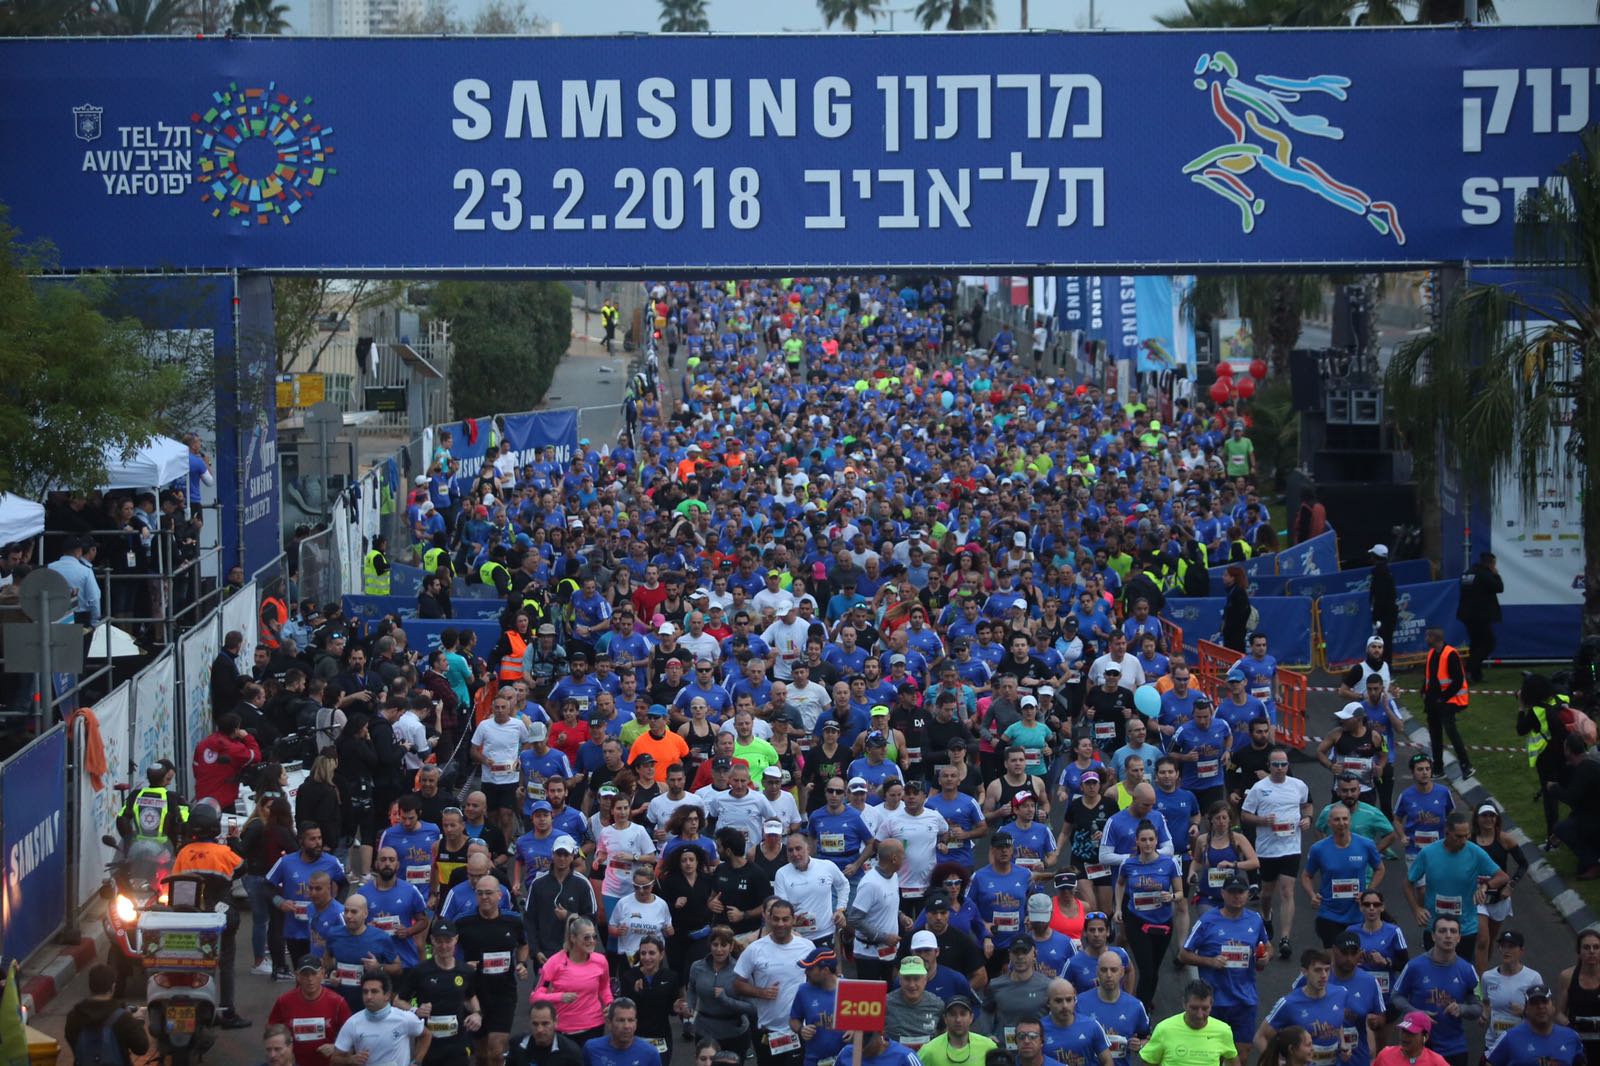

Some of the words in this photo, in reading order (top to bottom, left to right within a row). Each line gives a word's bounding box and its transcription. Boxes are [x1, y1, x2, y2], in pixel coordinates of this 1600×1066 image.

[452, 76, 852, 140] SAMSUNG
[877, 74, 1103, 152] מרתון
[1462, 67, 1600, 153] נוק
[118, 126, 158, 147] TEL
[158, 121, 191, 147] תל
[82, 150, 133, 171] AVIV
[135, 150, 191, 171] אביב
[103, 174, 159, 195] YAFO
[160, 173, 192, 194] יפו
[453, 167, 761, 231] 23.2.2018
[1461, 176, 1578, 226] STA
[840, 999, 882, 1017] 2:00
